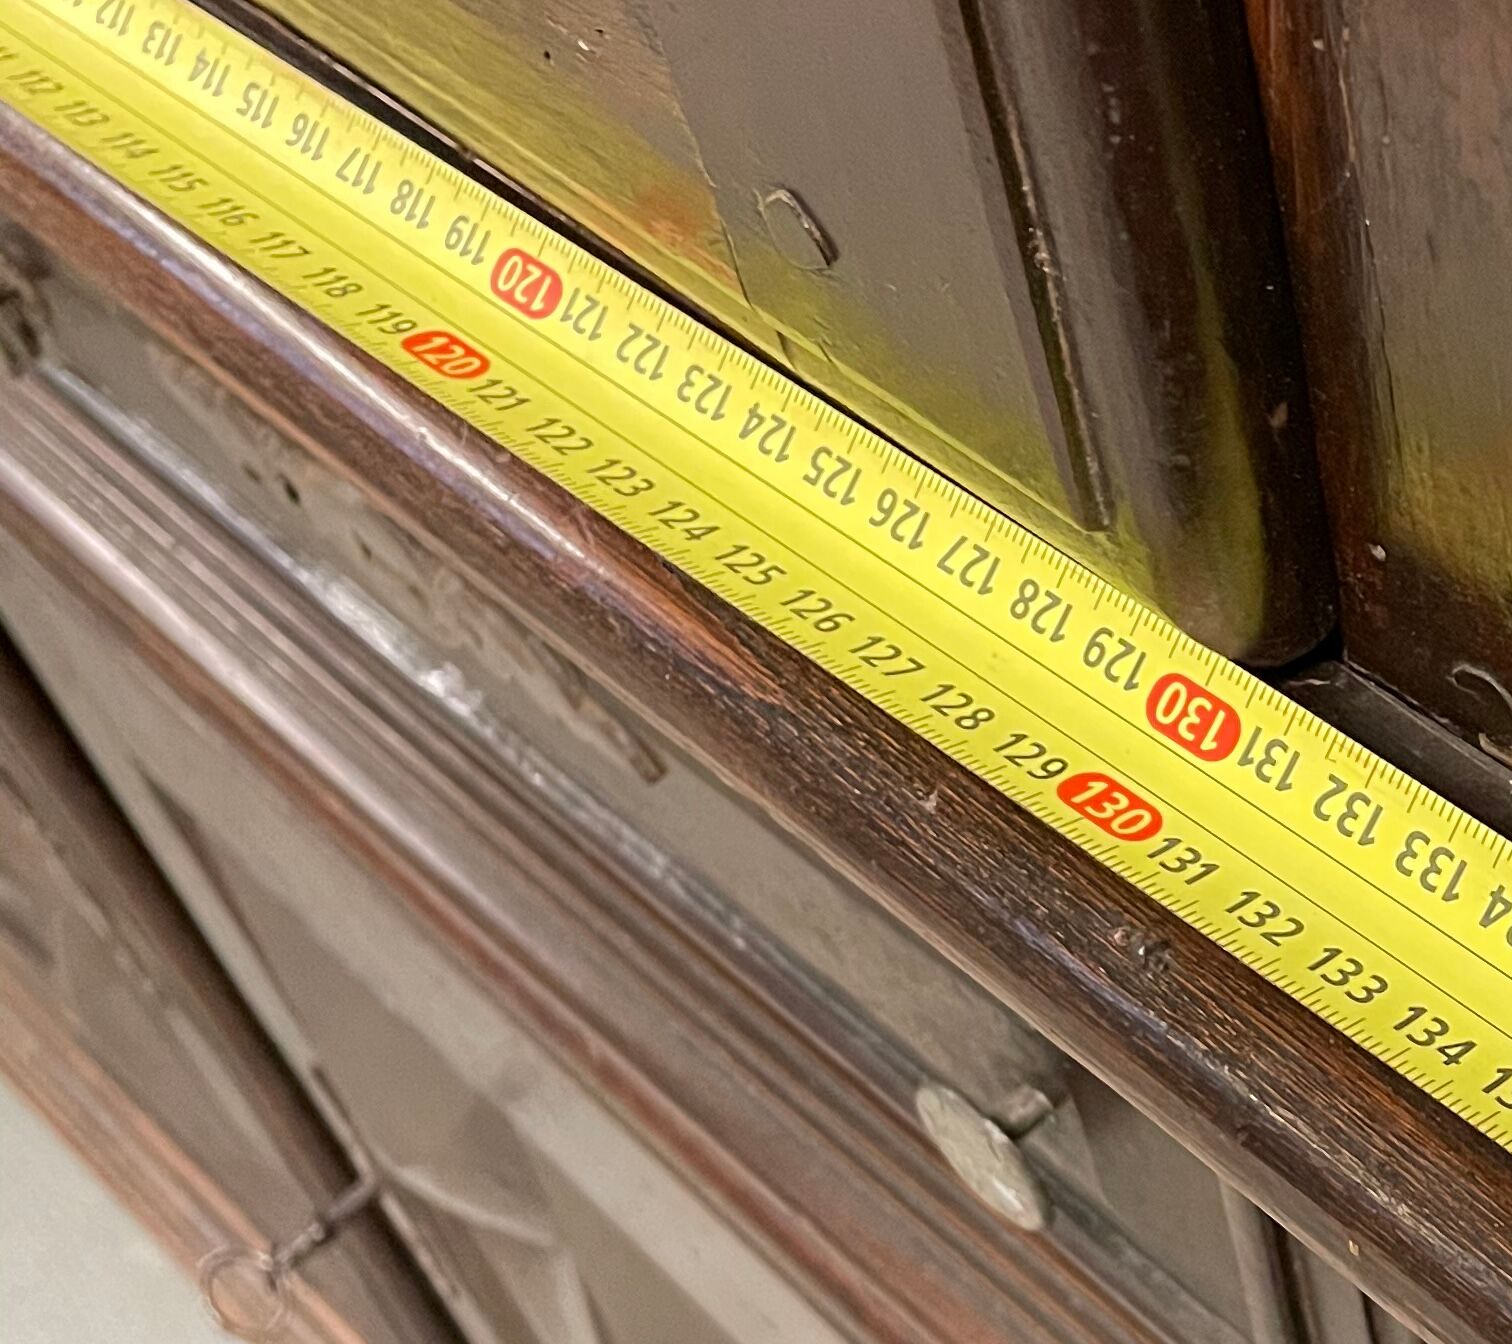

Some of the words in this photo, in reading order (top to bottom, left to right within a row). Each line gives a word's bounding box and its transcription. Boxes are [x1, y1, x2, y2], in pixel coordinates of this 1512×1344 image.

[141, 21, 182, 66] 113
[187, 48, 231, 97] 114
[236, 82, 279, 129] 115
[285, 114, 332, 161] 116
[336, 147, 382, 194] 117
[390, 179, 436, 230] 118
[444, 216, 491, 265] 119
[498, 256, 549, 312] 120
[560, 287, 609, 341] 121
[616, 324, 670, 379] 122
[676, 364, 732, 421] 123
[738, 402, 797, 464] 124
[802, 446, 862, 506] 125
[869, 487, 931, 549] 126
[937, 535, 1000, 596] 127
[1010, 579, 1073, 643] 128
[1083, 627, 1148, 693] 129
[1156, 681, 1227, 752] 130
[1237, 724, 1300, 791] 131
[1312, 774, 1383, 846] 132
[1395, 829, 1468, 903] 133
[149, 164, 207, 192] 115
[199, 197, 259, 227] 116
[249, 231, 310, 259] 117
[302, 267, 364, 300] 118
[355, 303, 416, 335] 119
[412, 335, 483, 375] 120
[467, 378, 531, 411] 121
[527, 417, 594, 456] 122
[587, 458, 655, 497] 123
[649, 500, 719, 541] 124
[714, 544, 787, 586] 125
[781, 588, 855, 633] 126
[849, 635, 925, 679] 127
[920, 683, 995, 730] 128
[994, 732, 1069, 780] 129
[1071, 779, 1149, 834] 130
[1147, 837, 1220, 885] 131
[1224, 888, 1304, 947] 132
[1308, 945, 1389, 1004] 133
[1393, 1004, 1479, 1066] 134
